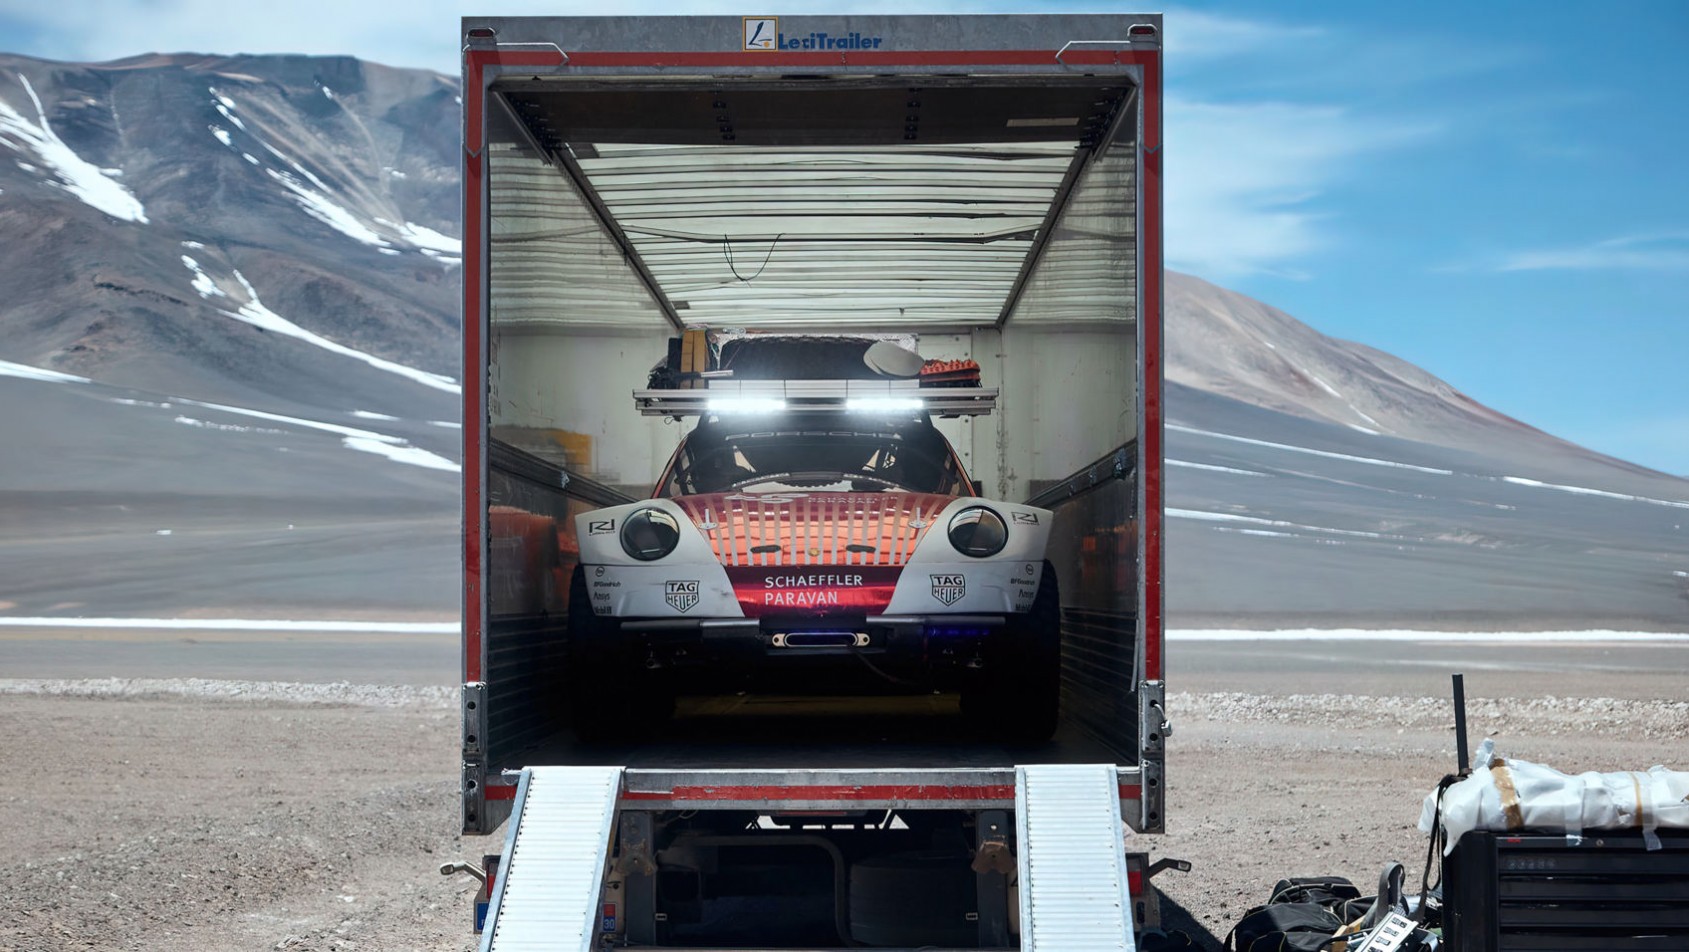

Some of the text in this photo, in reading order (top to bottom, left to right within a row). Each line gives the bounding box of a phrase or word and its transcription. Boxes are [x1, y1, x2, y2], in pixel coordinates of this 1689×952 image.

[668, 582, 697, 592] TAG
[764, 574, 863, 588] SCHAEFFLER
[933, 576, 963, 586] TAG
[667, 595, 697, 610] HEUER
[764, 591, 838, 605] PARAVAN
[934, 588, 964, 603] HEUER
[603, 918, 615, 929] 30
